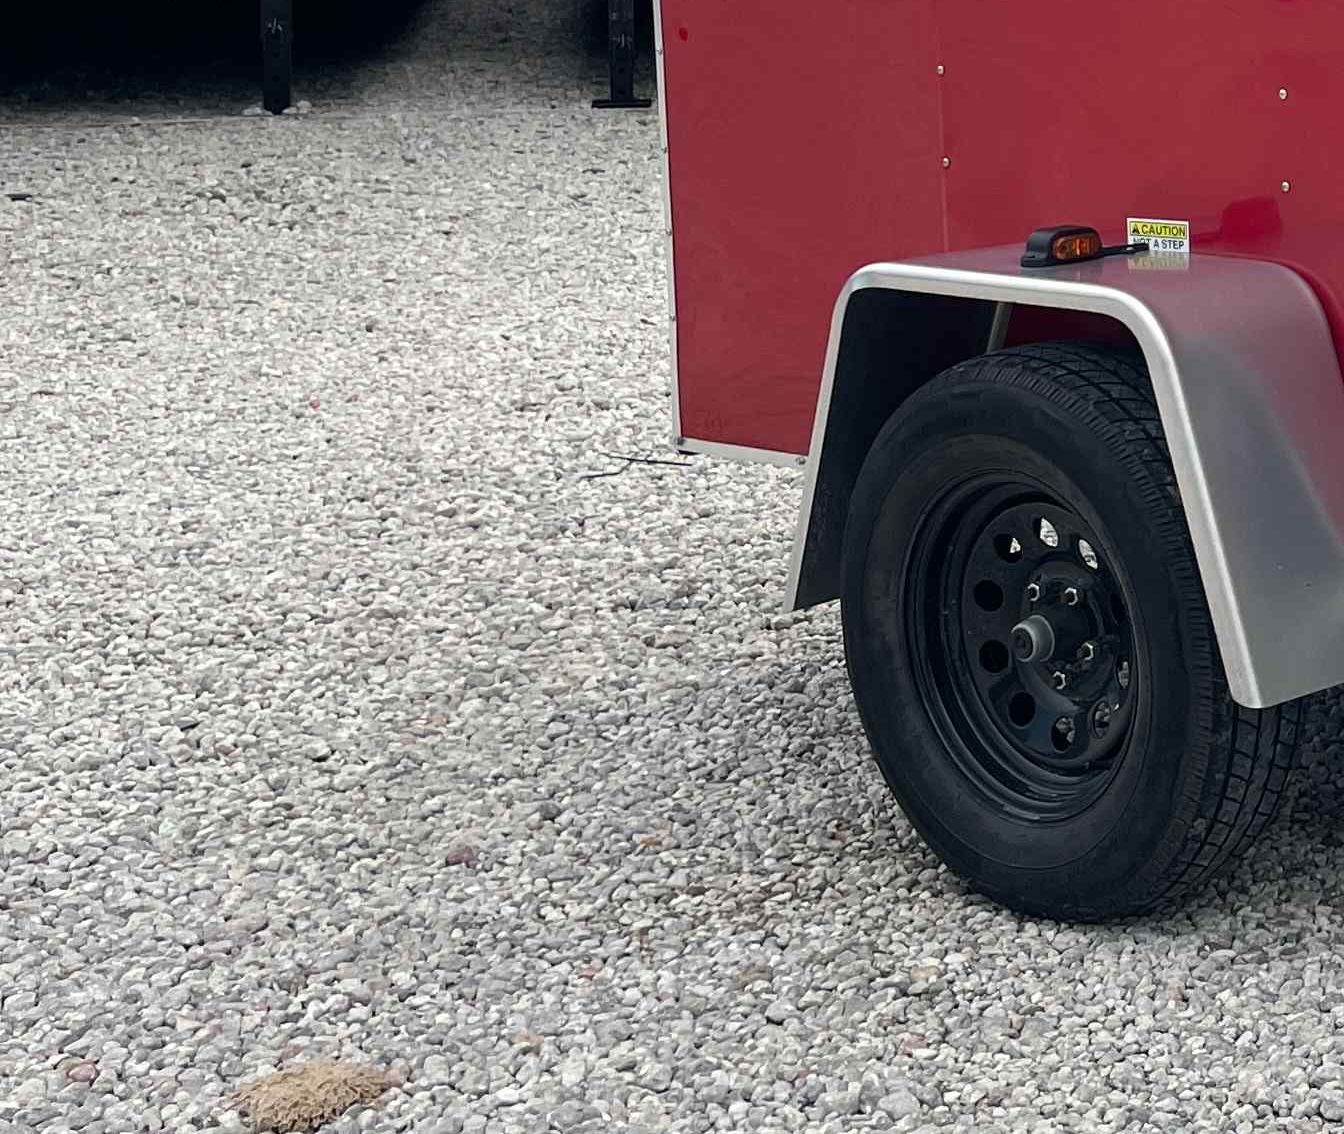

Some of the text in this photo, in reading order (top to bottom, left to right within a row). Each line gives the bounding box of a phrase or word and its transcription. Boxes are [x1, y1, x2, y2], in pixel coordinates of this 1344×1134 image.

[1141, 224, 1186, 237] CAUTION
[1153, 239, 1160, 249] A
[1161, 239, 1185, 250] STEP
